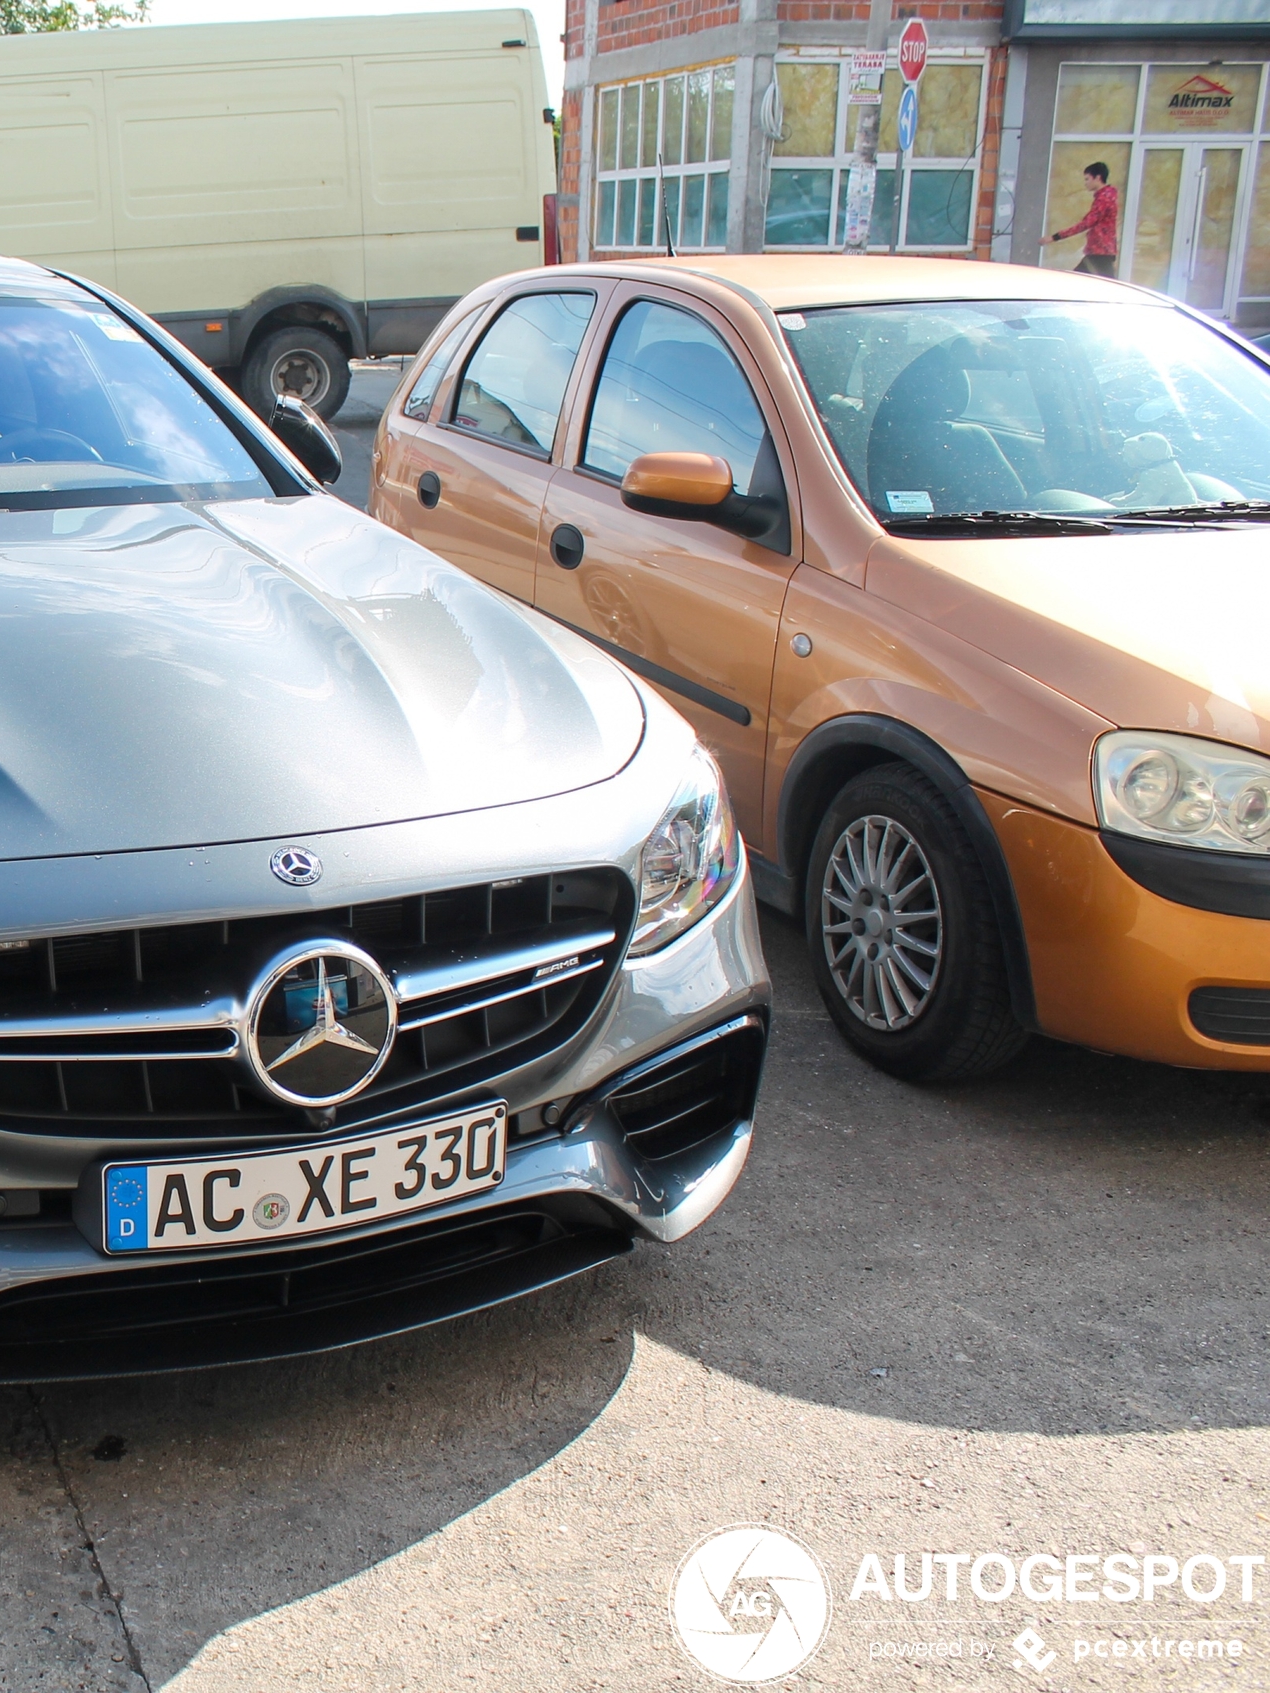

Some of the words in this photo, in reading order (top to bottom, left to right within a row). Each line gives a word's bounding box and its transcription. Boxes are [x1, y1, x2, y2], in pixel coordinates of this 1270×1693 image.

[902, 41, 925, 63] STOP
[1168, 93, 1234, 108] Altimax
[550, 956, 579, 973] AMG
[154, 1167, 244, 1238] AC
[297, 1147, 377, 1223] XE
[394, 1117, 497, 1200] 330
[119, 1218, 135, 1237] D
